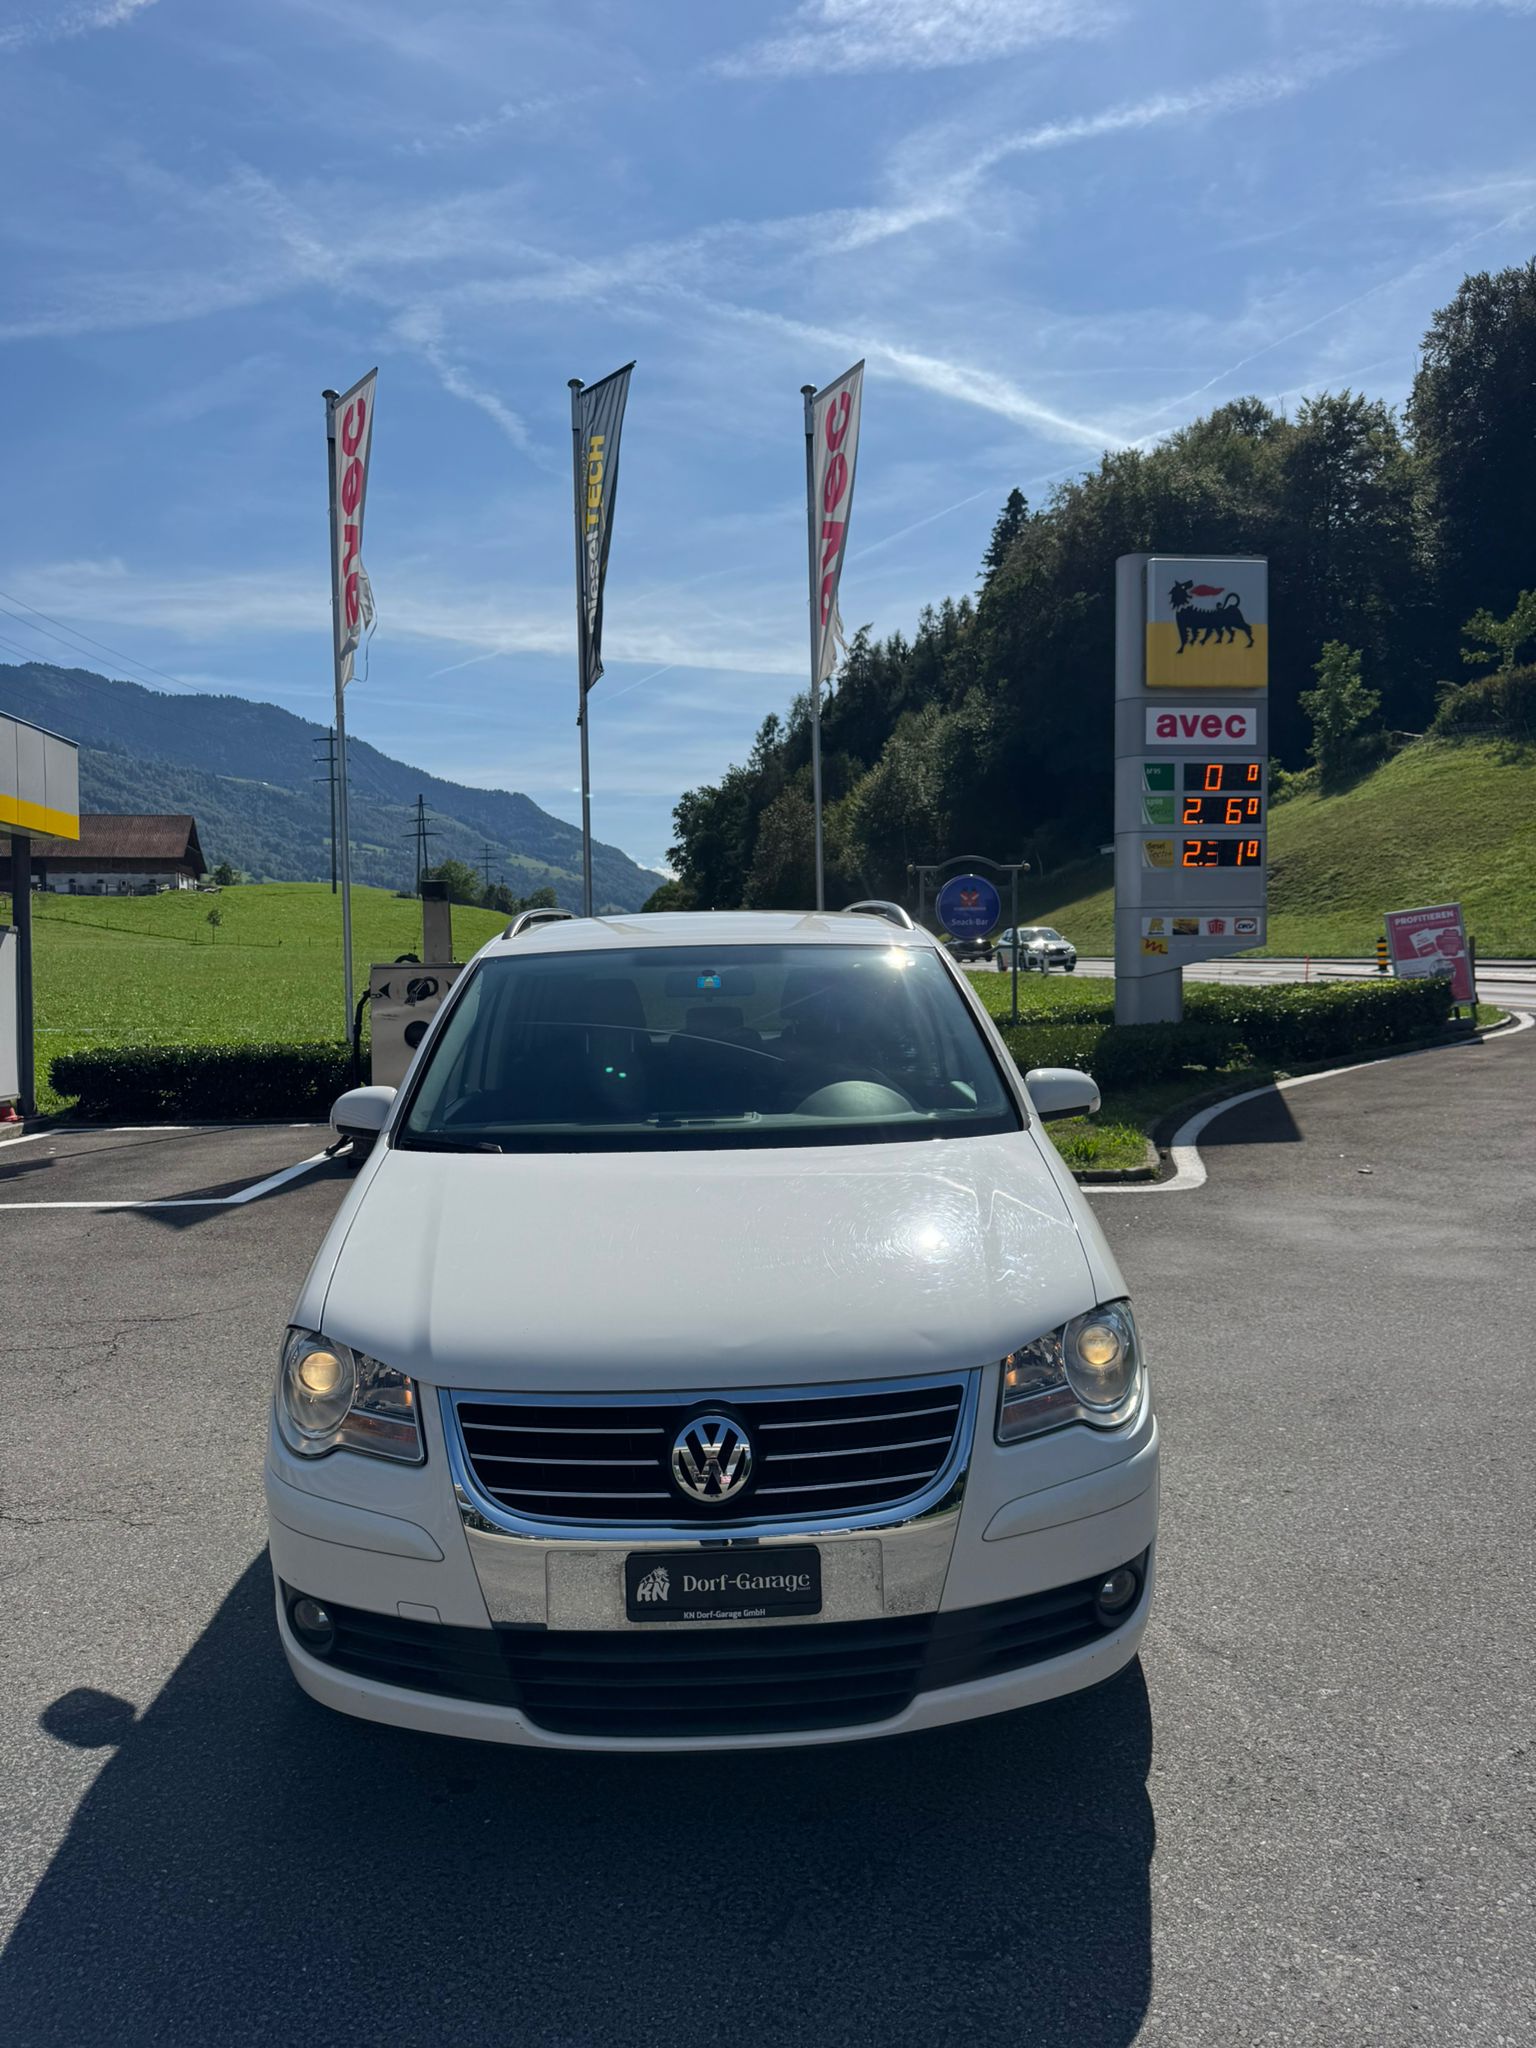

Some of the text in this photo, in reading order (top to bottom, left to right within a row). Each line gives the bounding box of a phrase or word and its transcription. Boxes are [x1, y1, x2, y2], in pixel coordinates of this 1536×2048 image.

[342, 398, 366, 630] avec
[1156, 713, 1247, 739] avec
[1395, 910, 1454, 926] PROFITIEREN
[636, 1573, 811, 1603] KN Dorf-Garage
[684, 1608, 766, 1620] KN Dorf-Garage GmbH
